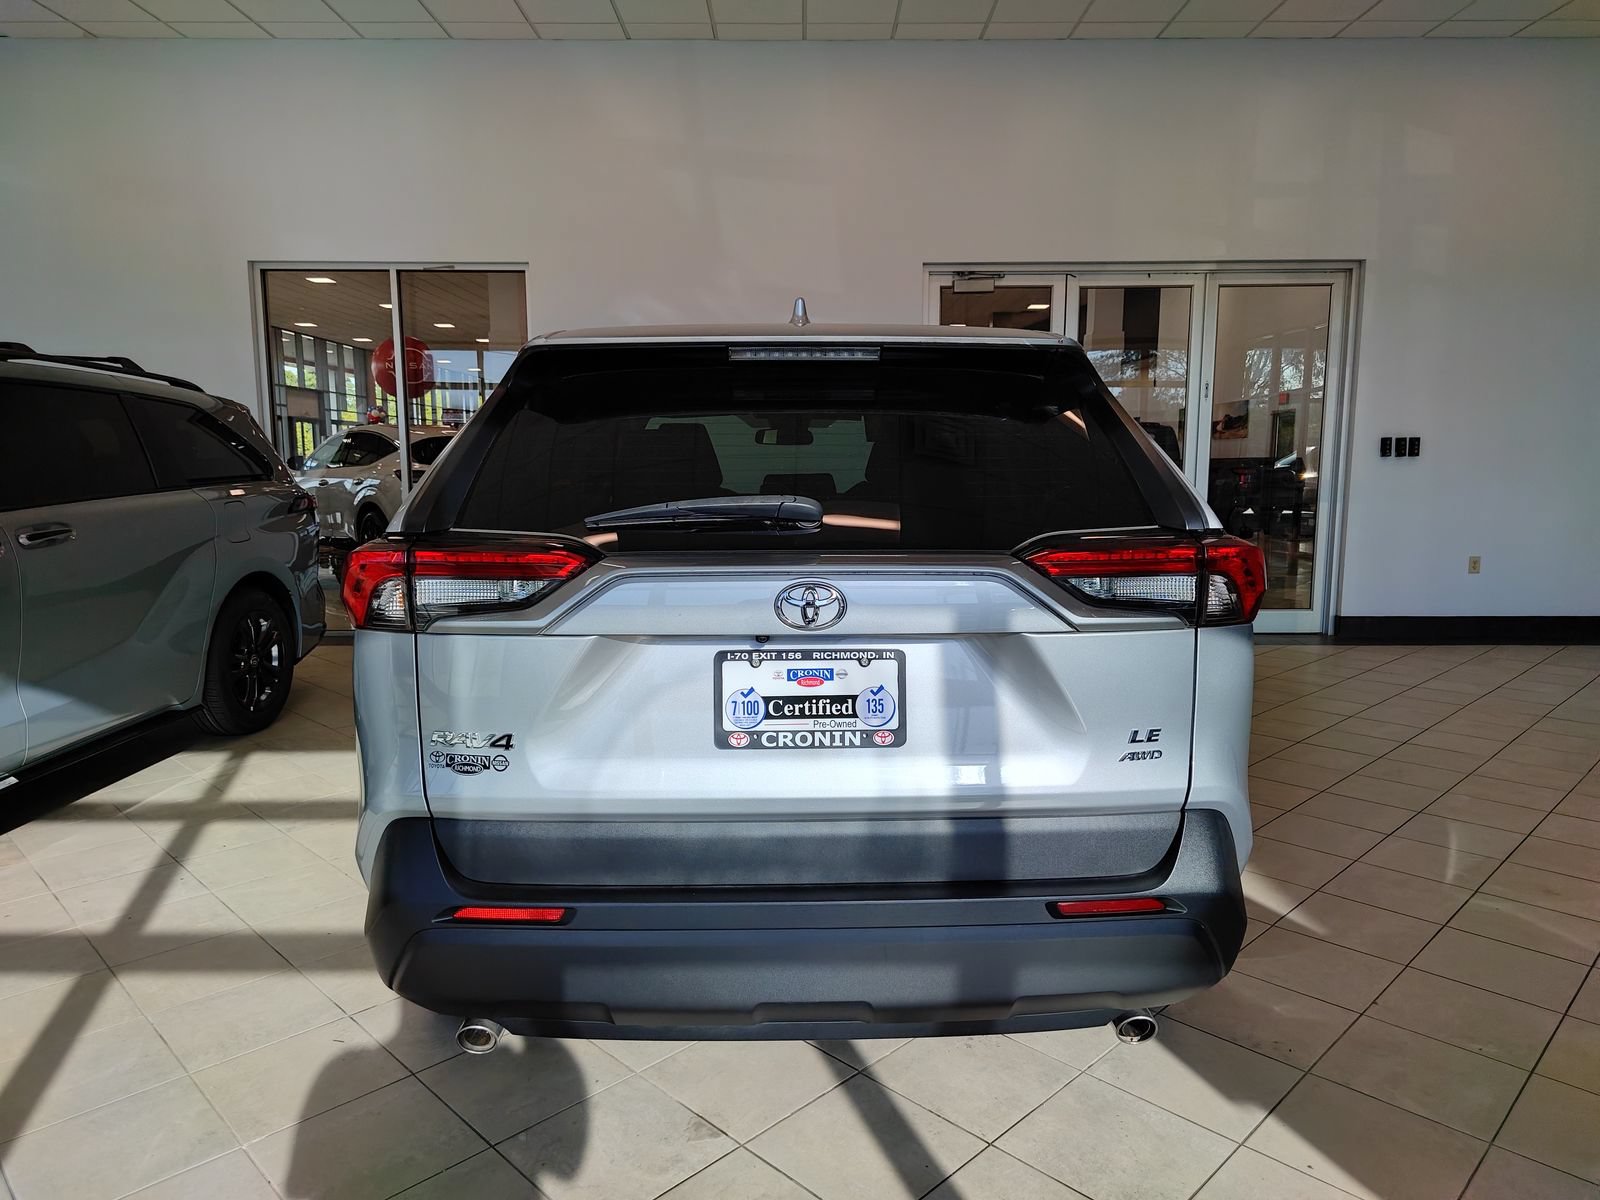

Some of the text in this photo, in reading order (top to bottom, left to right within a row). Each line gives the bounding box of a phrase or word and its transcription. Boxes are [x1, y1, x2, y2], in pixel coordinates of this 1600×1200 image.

[727, 651, 895, 660] I-70 EXIT 156 RICHMOND, IN
[789, 669, 831, 680] CRONIN
[768, 698, 854, 717] Certified
[866, 698, 885, 714] 135
[813, 719, 858, 729] Pre-Owned
[430, 730, 515, 750] RAV4
[761, 731, 861, 747] CRONIN
[1128, 728, 1162, 744] LE
[447, 754, 490, 768] CRONIN
[1118, 749, 1163, 762] AWD
